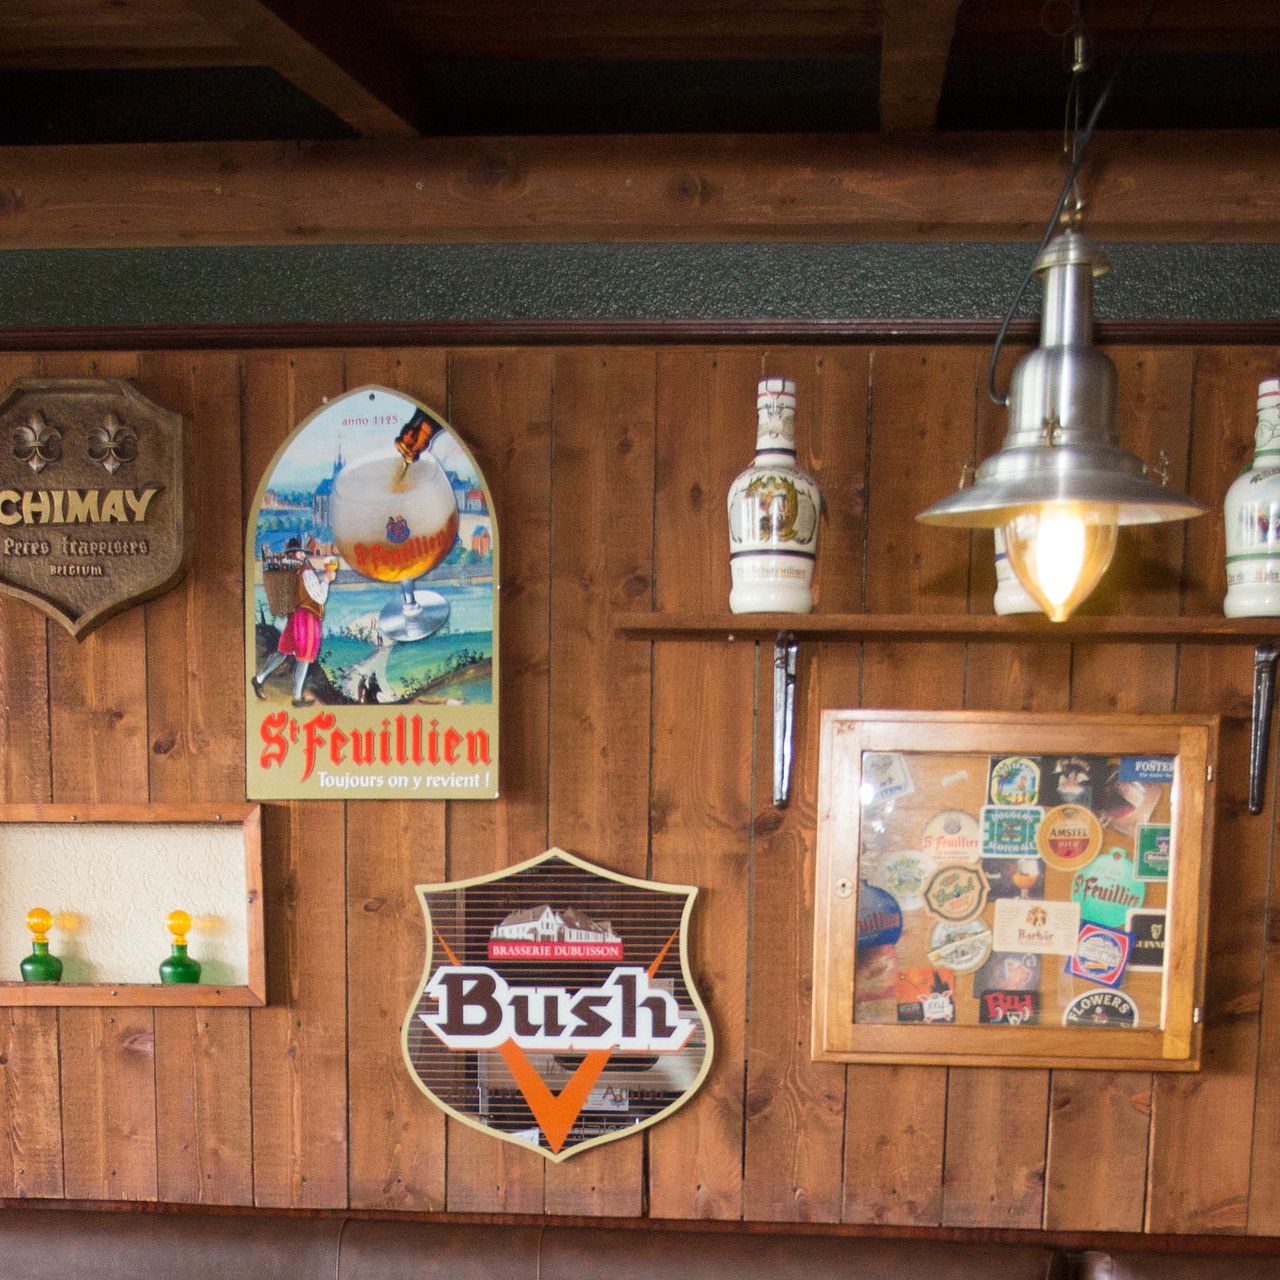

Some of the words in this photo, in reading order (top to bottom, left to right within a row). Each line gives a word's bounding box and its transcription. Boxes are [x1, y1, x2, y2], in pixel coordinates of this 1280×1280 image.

[317, 771, 385, 790] Toujours
[387, 774, 409, 788] on
[412, 775, 423, 791] y
[426, 773, 480, 788] revient
[1050, 828, 1088, 838] AMSTEL
[492, 945, 552, 956] BRASSERIE
[553, 945, 620, 957] DUBUISSON
[433, 970, 681, 1040] Bush
[1069, 993, 1130, 1021] FLOWERS
